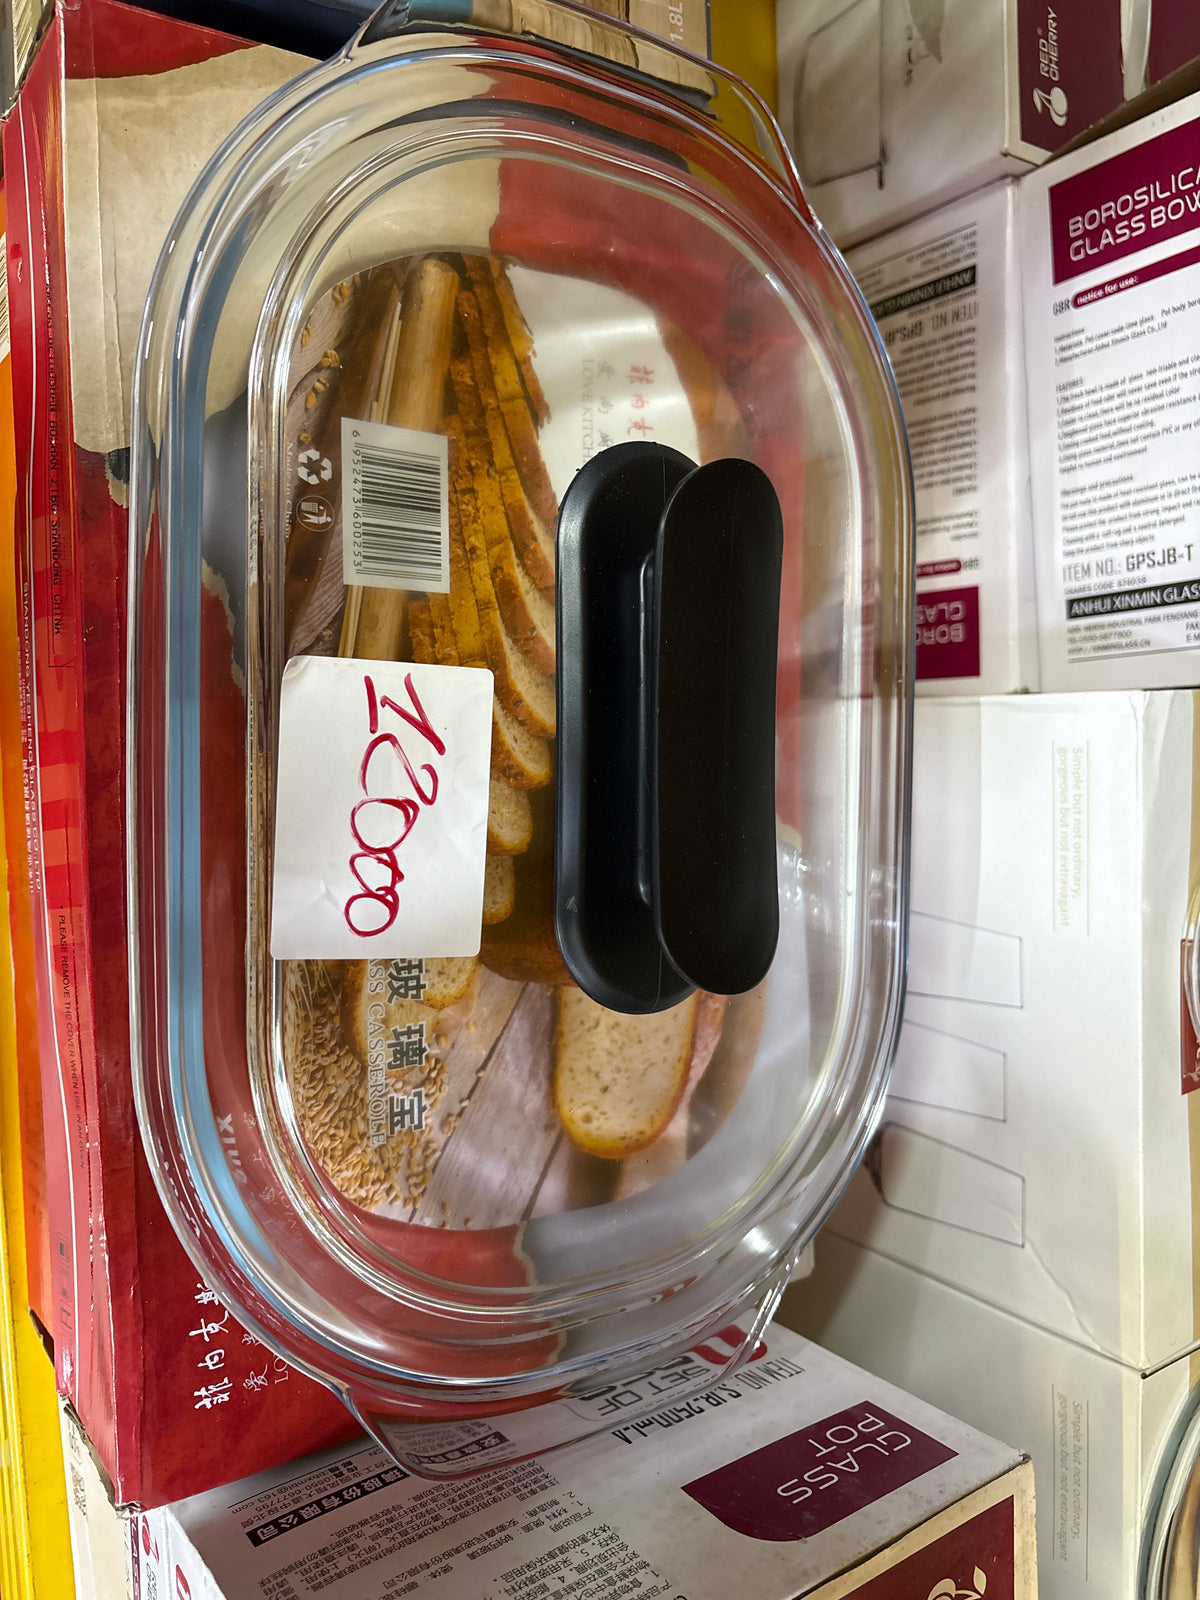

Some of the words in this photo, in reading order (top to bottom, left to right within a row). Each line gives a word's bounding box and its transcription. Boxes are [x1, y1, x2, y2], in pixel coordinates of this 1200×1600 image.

[668, 2, 684, 43] 1.8L
[1039, 38, 1049, 77] RED
[1047, 6, 1060, 81] CHERRY
[1069, 213, 1146, 262] GLASS
[1077, 289, 1104, 306] notice
[1105, 283, 1118, 294] for
[352, 430, 361, 438] 6
[352, 448, 362, 504] 952473
[285, 499, 293, 539] China
[51, 521, 59, 586] SHANDONG
[352, 511, 362, 568] 600253
[1063, 561, 1091, 583] ITEM
[1125, 544, 1193, 573] GPSJB-T
[1070, 598, 1111, 617] ANHUI
[1112, 590, 1161, 610] XINMIN
[1056, 747, 1069, 804] gorgeous
[1072, 747, 1082, 791] Simple
[344, 672, 447, 938] 12000
[1059, 807, 1070, 829] but
[1073, 793, 1082, 815] but
[1059, 831, 1070, 853] not
[1073, 818, 1082, 840] not
[58, 915, 67, 953] PLEASE
[61, 956, 71, 998] REMOVE
[64, 1000, 72, 1021] THE
[66, 1023, 76, 1057] COVER
[70, 1060, 79, 1090] WHEN
[368, 1003, 388, 1147] CASSEROLE
[651, 1364, 711, 1396] SET
[765, 1357, 807, 1382] ITEM
[597, 1389, 645, 1417] OF
[1056, 1393, 1068, 1450] gorgeous
[1072, 1400, 1083, 1441] Simple
[808, 1413, 885, 1458] POT
[1073, 1443, 1083, 1465] but
[776, 1429, 912, 1506] GLASS
[1059, 1451, 1070, 1470] but
[1072, 1466, 1082, 1486] not
[516, 1477, 558, 1502] 注意事项
[1059, 1471, 1070, 1492] not
[255, 1468, 403, 1542] 璃股份有限公司
[549, 1507, 594, 1533] 产品说明
